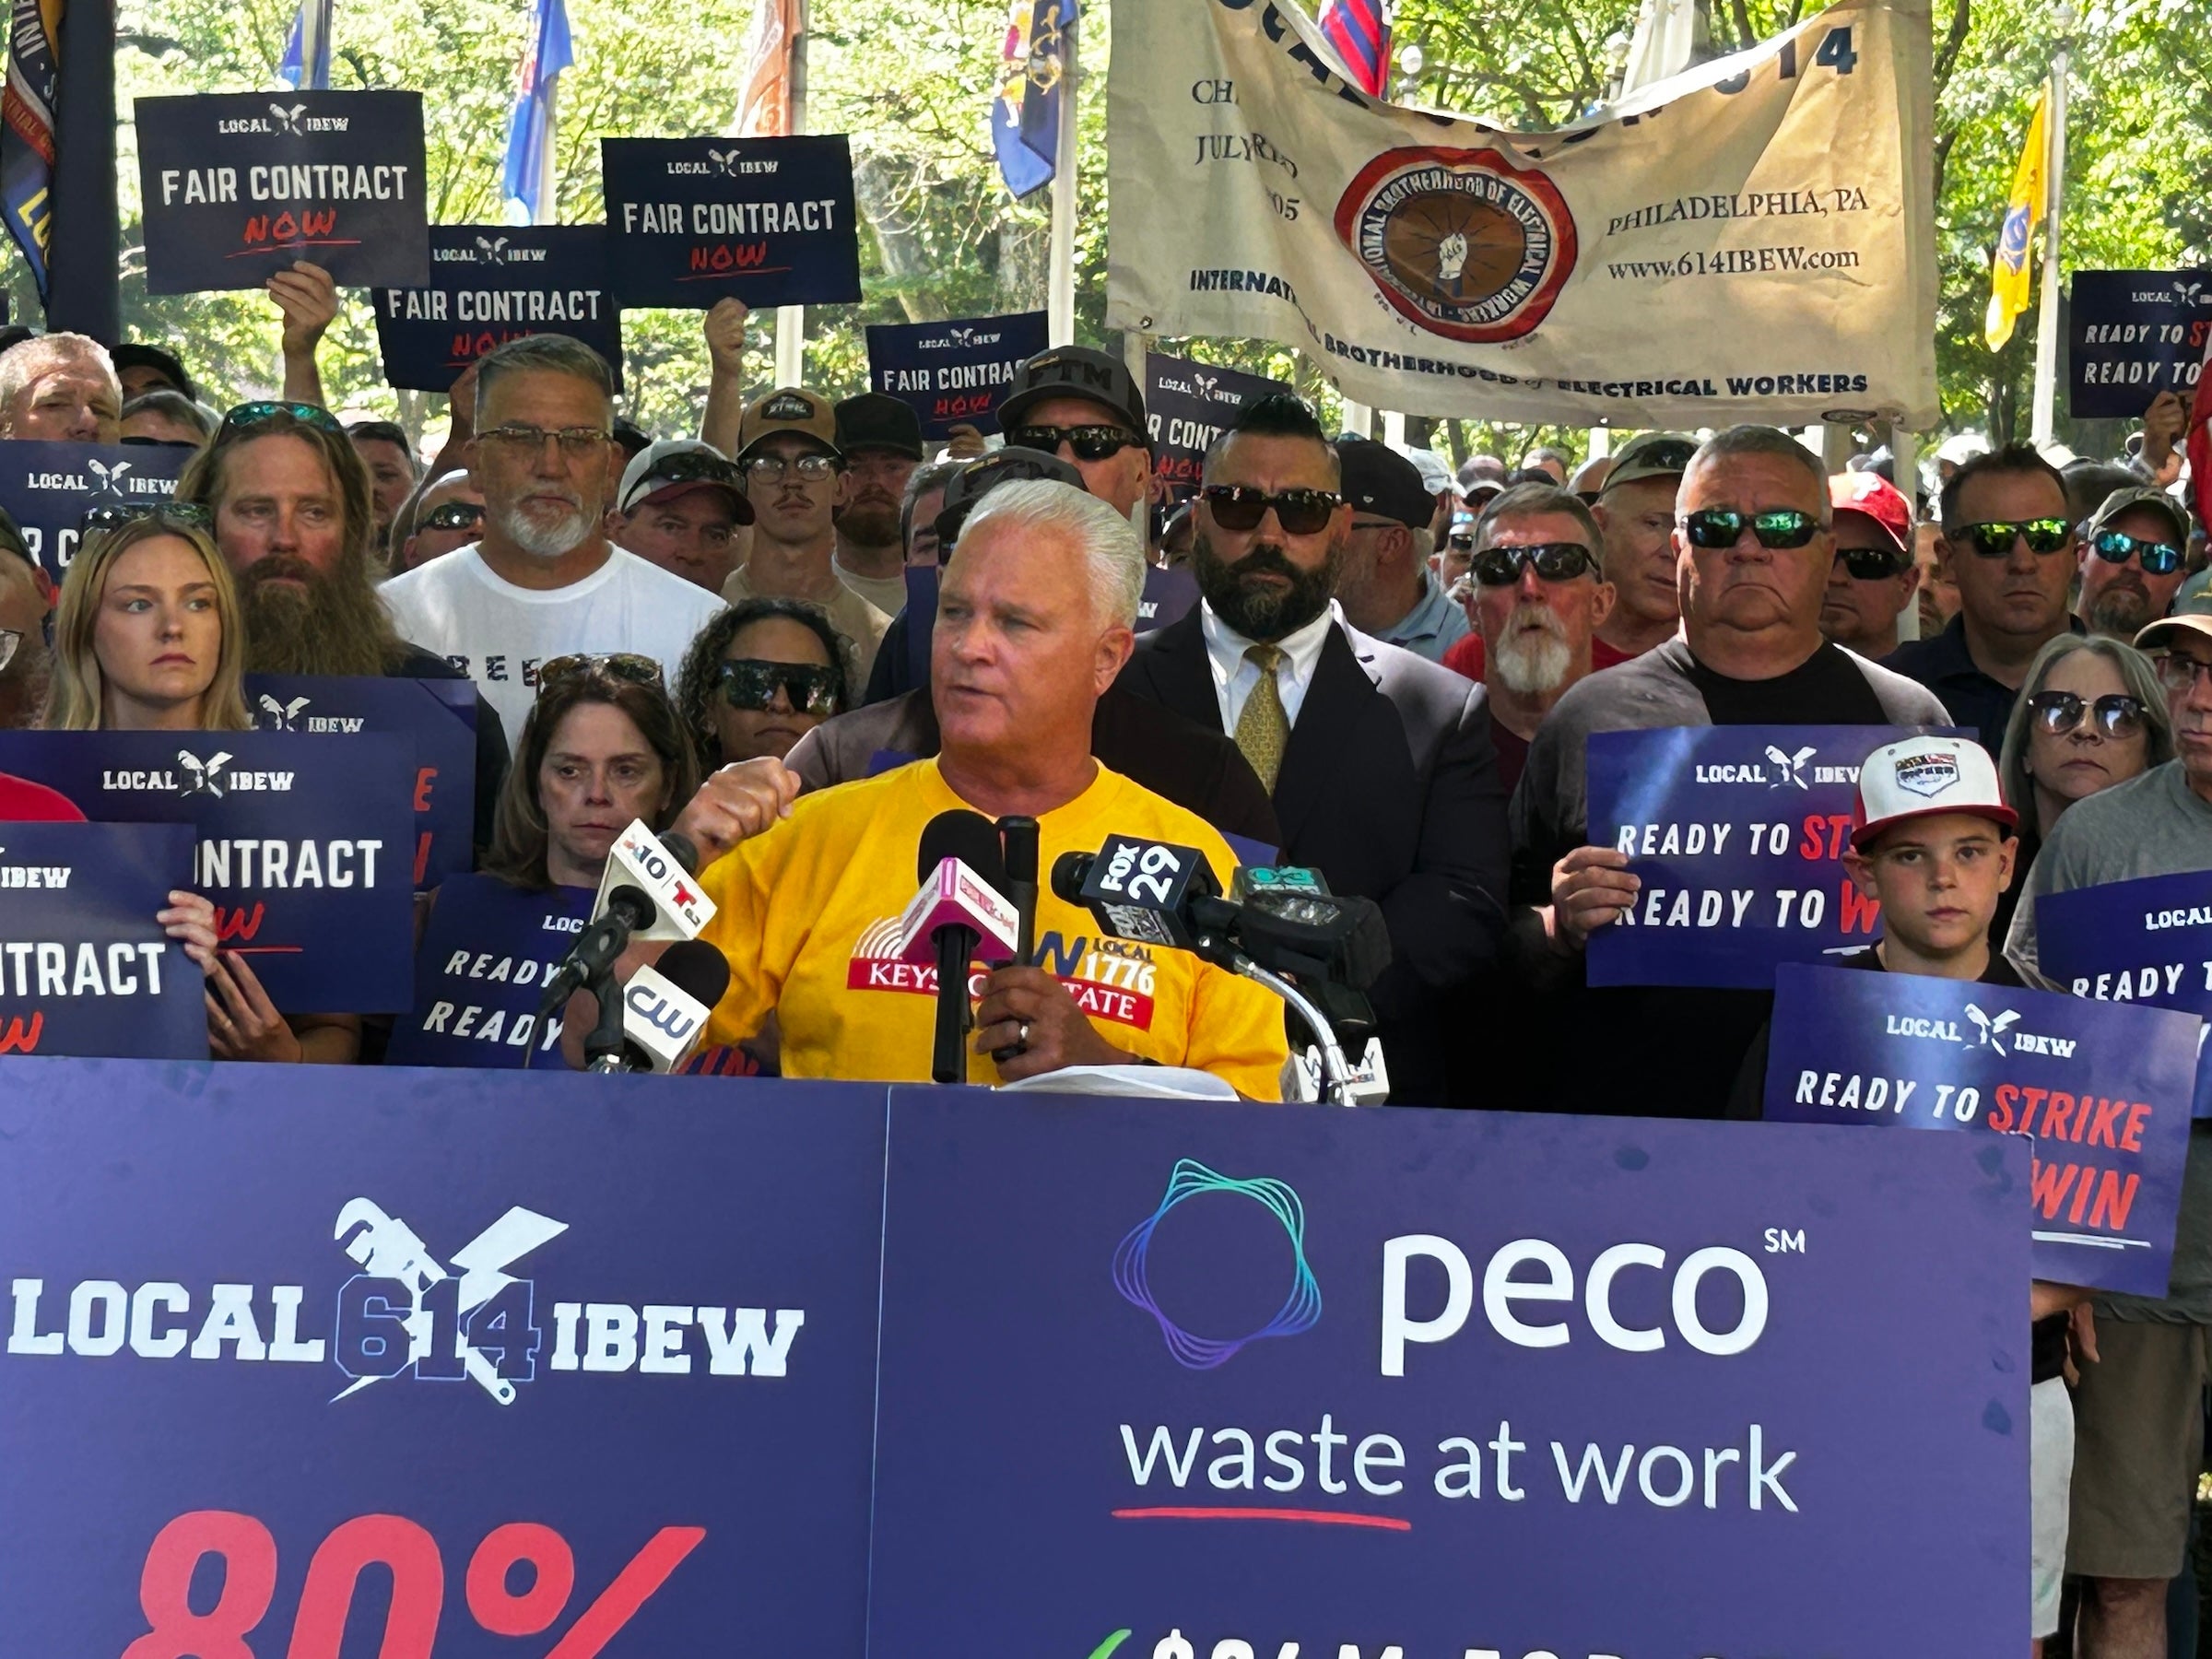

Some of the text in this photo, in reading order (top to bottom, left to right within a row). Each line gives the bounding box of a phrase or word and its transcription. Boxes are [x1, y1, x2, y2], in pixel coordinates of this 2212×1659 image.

[218, 118, 271, 135] LOCAL
[161, 165, 408, 206] FAIR CONTRACT
[667, 161, 711, 175] LOCAL
[244, 206, 336, 244] NOW
[623, 199, 836, 235] FAIR CONTRACT
[1606, 187, 1870, 236] PHILADELPHIA, PA
[433, 248, 477, 262] LOCAL
[691, 241, 767, 271] NOW
[1607, 247, 1860, 280] www.614IBEW.com
[387, 288, 602, 322] FAIR CONTRACT
[2085, 324, 2150, 344] READY
[2159, 324, 2184, 344] TO
[883, 369, 931, 393] FAIR
[1726, 372, 1868, 396] WORKERS
[2085, 361, 2204, 385] READY TO
[933, 393, 992, 415] NOW
[28, 473, 88, 490] LOCAL
[103, 771, 295, 791] LOCAL IBEW
[1696, 764, 1767, 784] LOCAL
[1617, 822, 1732, 858] READY
[1750, 822, 1791, 855] TO
[0, 866, 72, 888] IBEW
[194, 838, 383, 889] NTRACT
[1100, 842, 1181, 903] FOX 29
[1615, 888, 1755, 929] READY
[1775, 888, 1826, 929] TO
[2145, 906, 2212, 931] LOCAL
[0, 942, 166, 997] TRACT
[444, 950, 563, 988] READY
[1084, 952, 1157, 996] 1776
[2072, 963, 2184, 1002] READY
[422, 1001, 564, 1052] READY
[1887, 1015, 1962, 1042] LOCAL
[1794, 1070, 2153, 1153] READY TO STRIKE
[2031, 1158, 2141, 1231] WIN
[1380, 1227, 1806, 1378] peco SM
[7, 1272, 805, 1382] LOCAL 614 IBEW
[1120, 1413, 1798, 1513] waste at work
[119, 1510, 707, 1659] 80%
